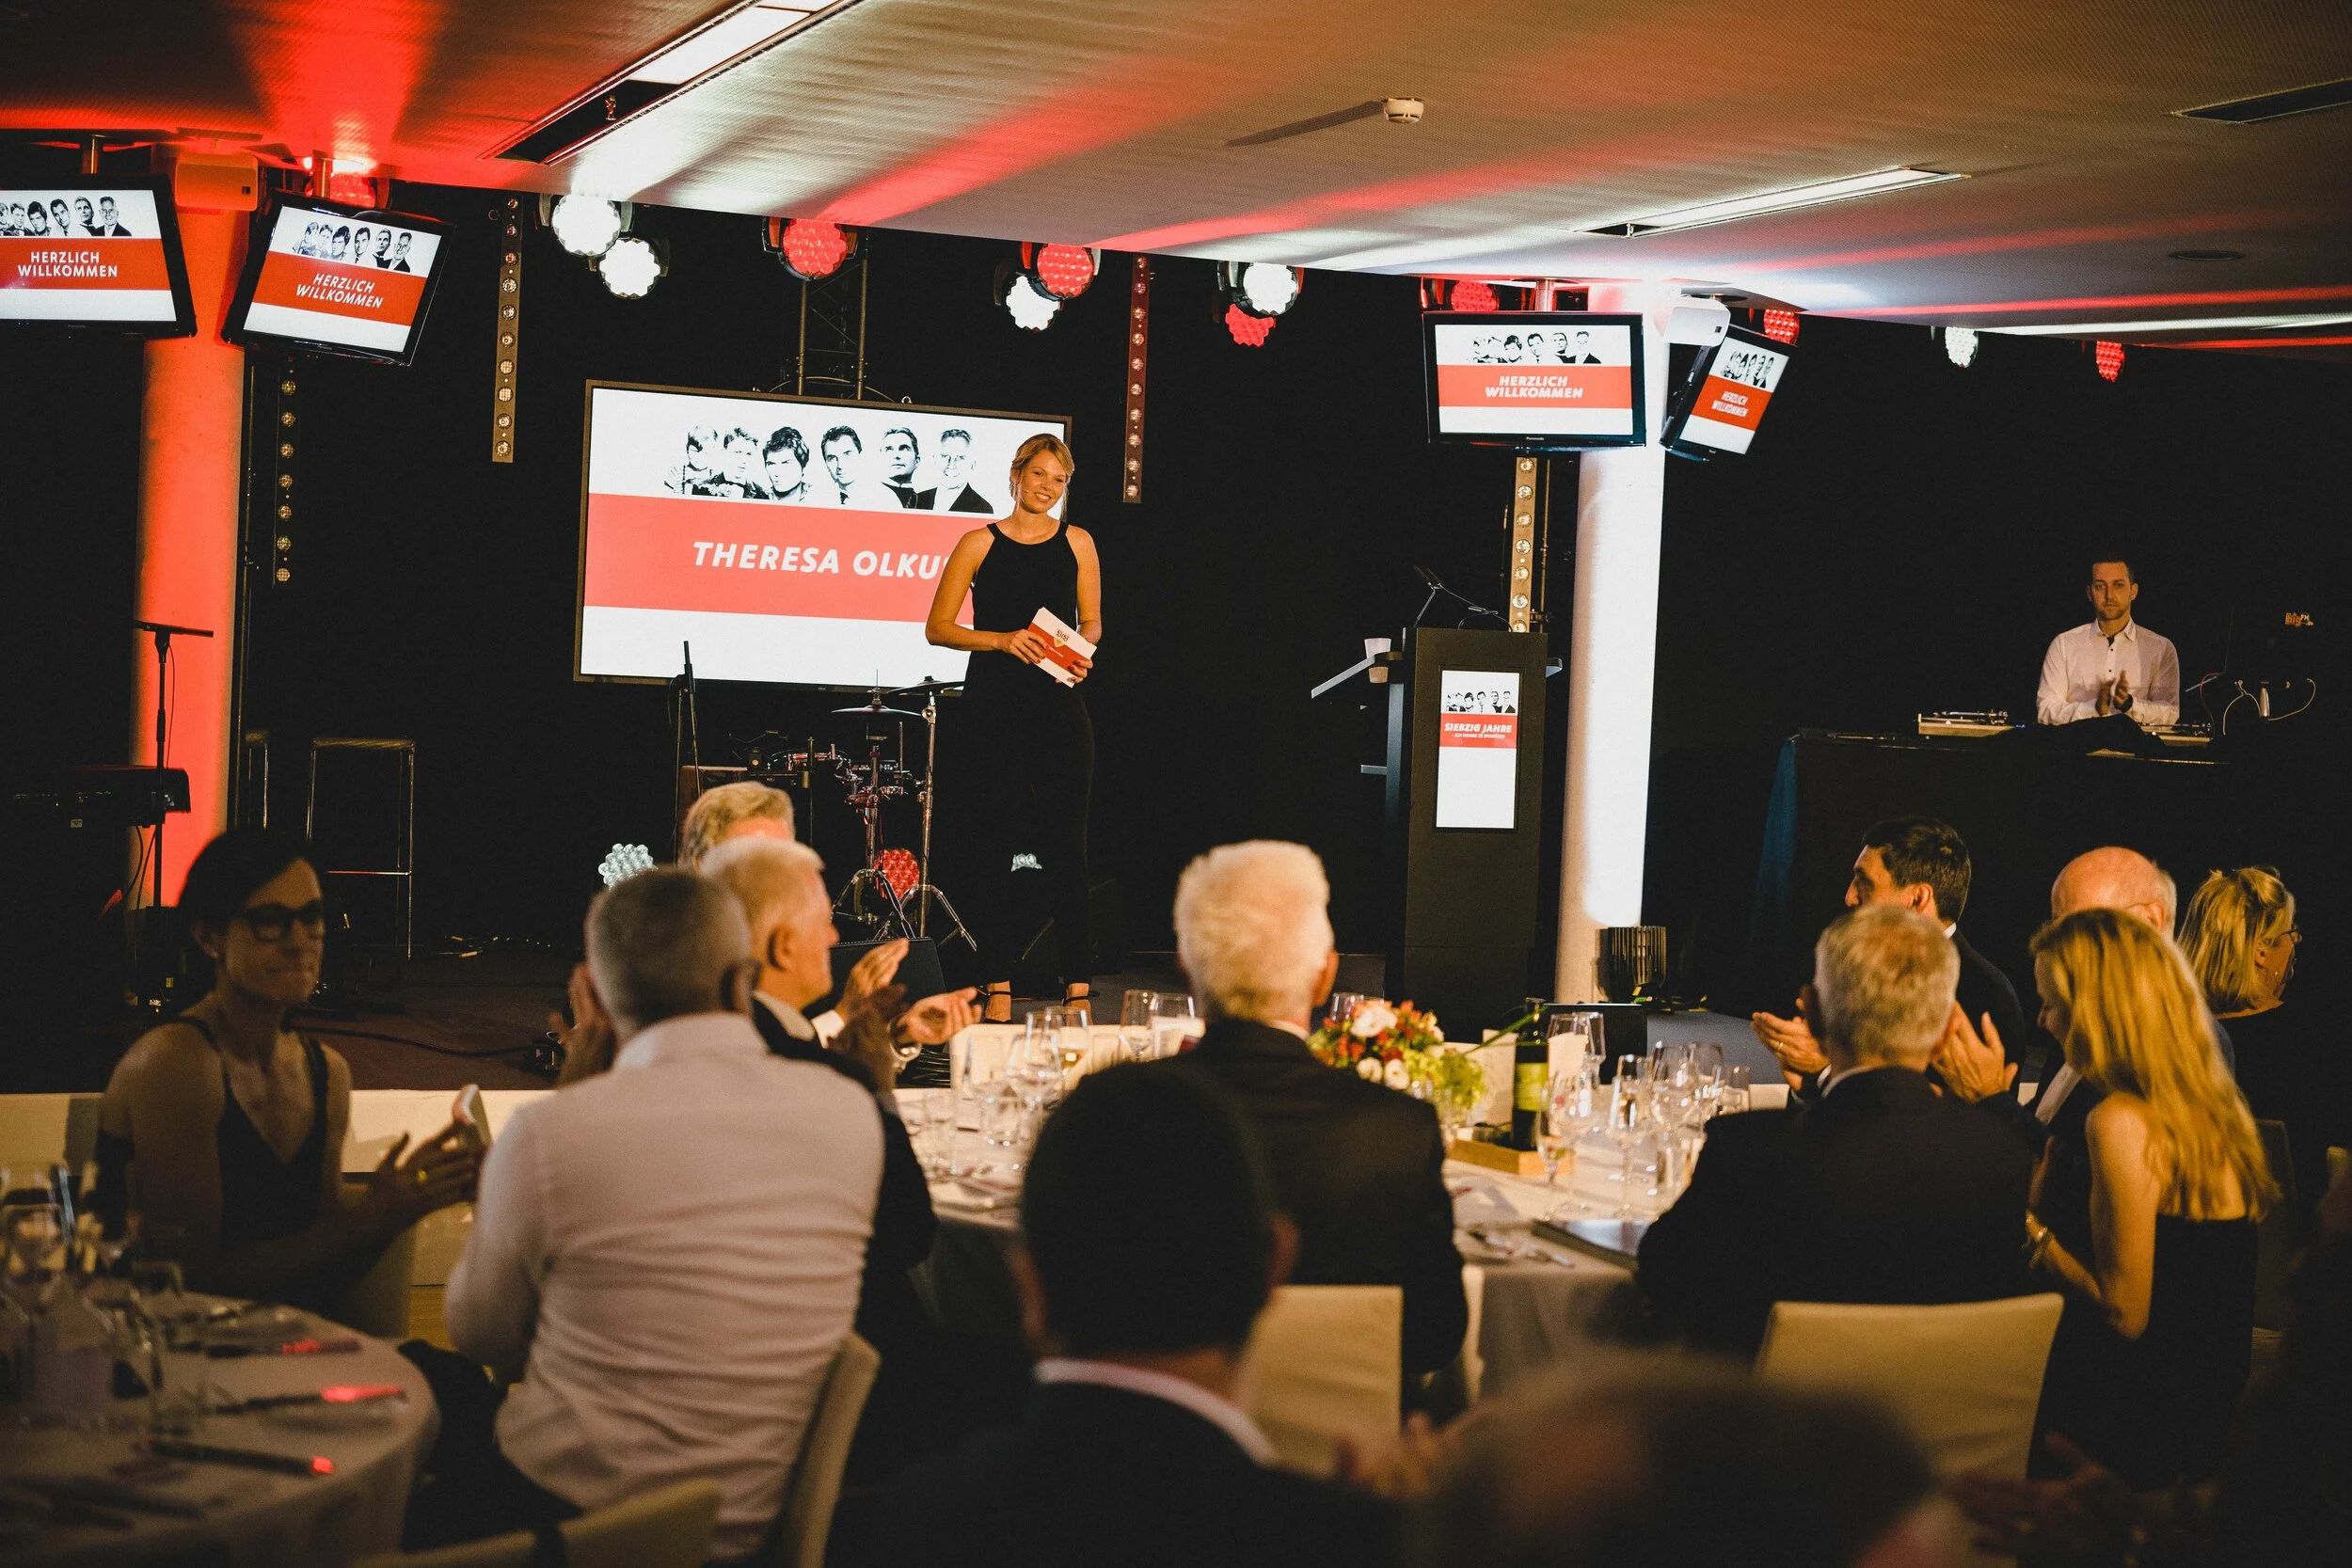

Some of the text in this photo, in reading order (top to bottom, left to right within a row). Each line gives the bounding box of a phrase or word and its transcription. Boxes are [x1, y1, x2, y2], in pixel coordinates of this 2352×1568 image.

[30, 251, 100, 263] HERZLICH
[17, 264, 119, 277] WILLKOMMEN
[312, 273, 375, 293] HERZLICH
[295, 284, 384, 309] WILLKOMMEN
[1499, 375, 1568, 387] HERZLICH
[1485, 387, 1583, 399] WILLKOMMEN
[692, 541, 949, 580] THERESA OLKU
[1444, 722, 1513, 734] SIEBZIG JAHRE
